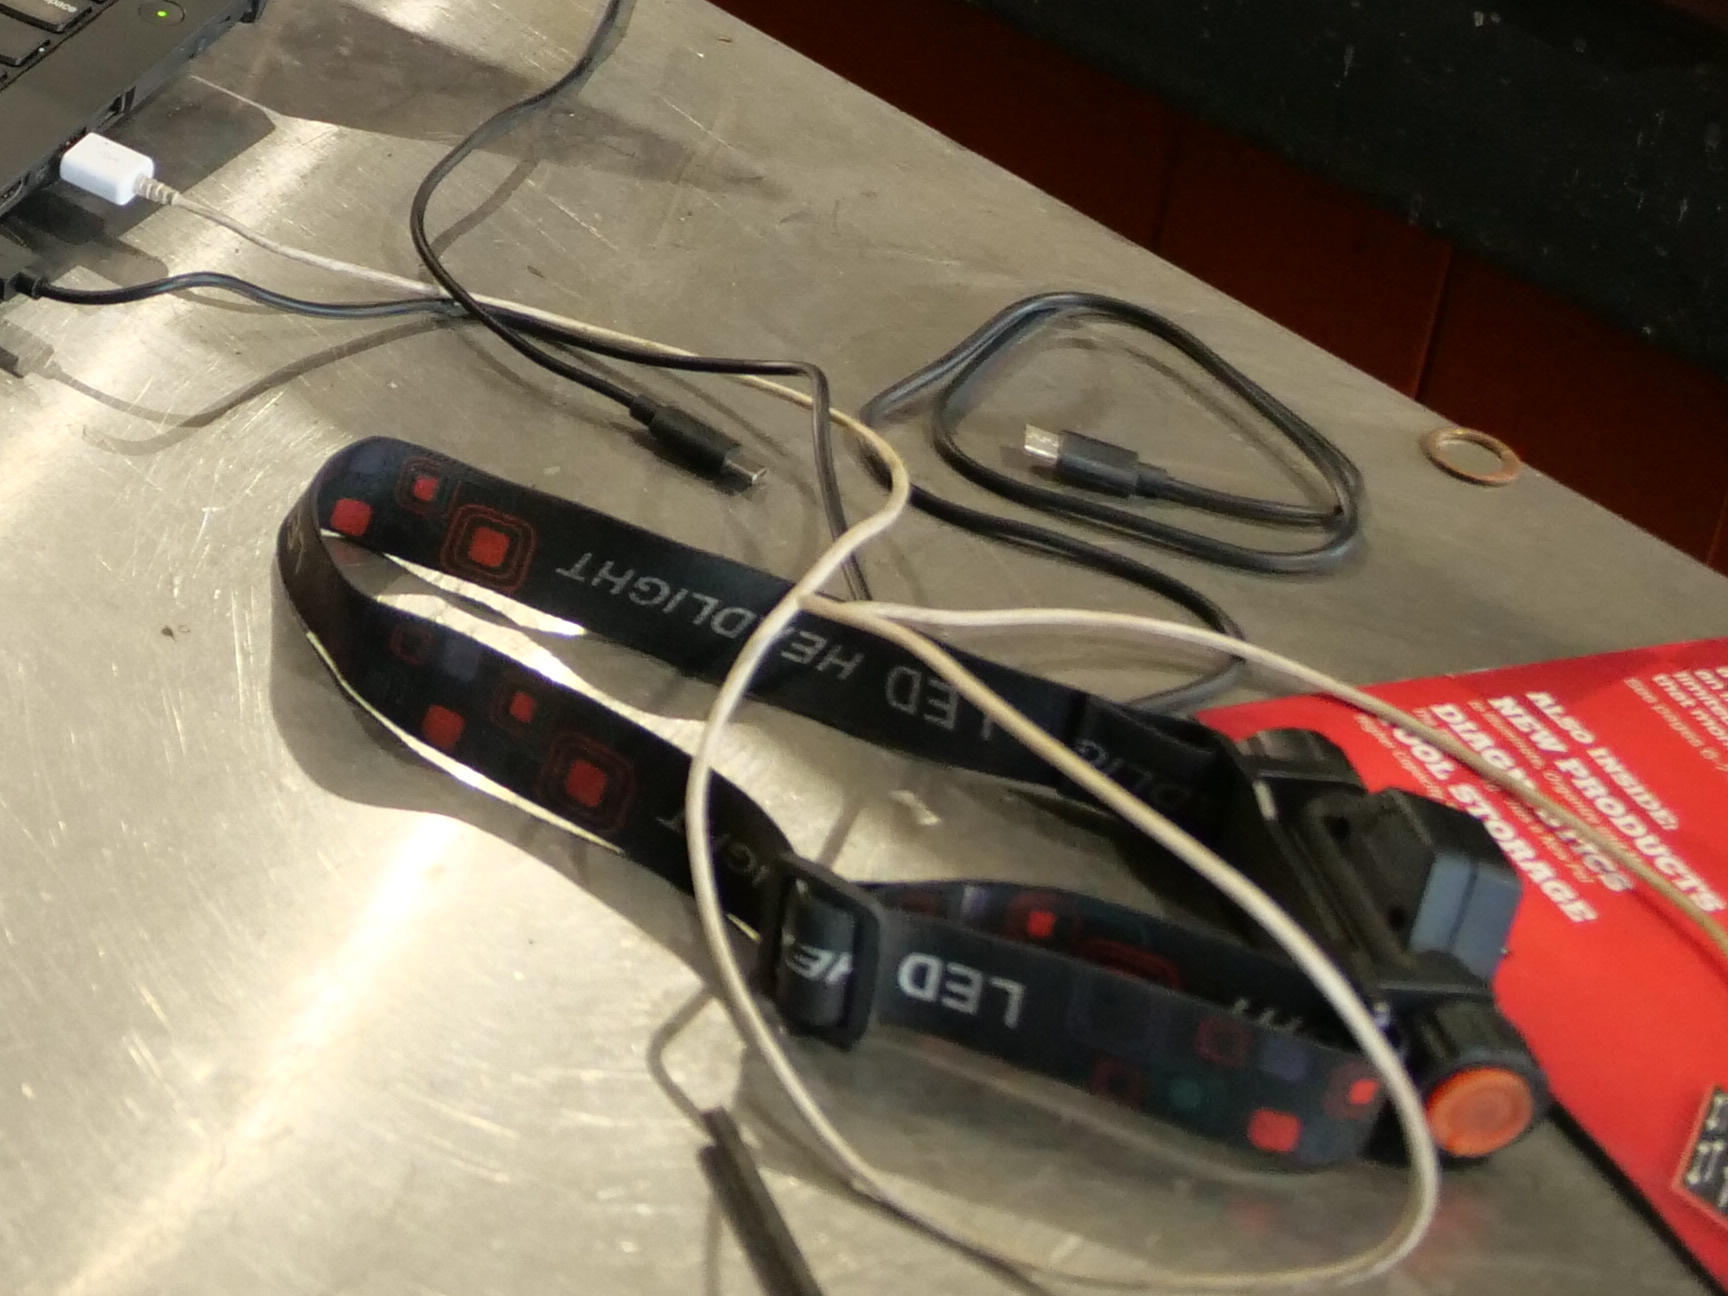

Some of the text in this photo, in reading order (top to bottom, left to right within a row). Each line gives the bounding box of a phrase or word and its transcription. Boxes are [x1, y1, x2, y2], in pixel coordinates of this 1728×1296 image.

[555, 551, 868, 681] HEDLIGHT
[1650, 703, 1705, 747] pages
[1651, 673, 1696, 708] that
[1487, 695, 1569, 754] NEW
[1555, 757, 1728, 913] PRODUCTS
[1525, 690, 1596, 745] ALSO
[1587, 747, 1679, 831] INSIDE:
[1448, 783, 1599, 923] STORAGE
[897, 951, 1026, 1029] LED
